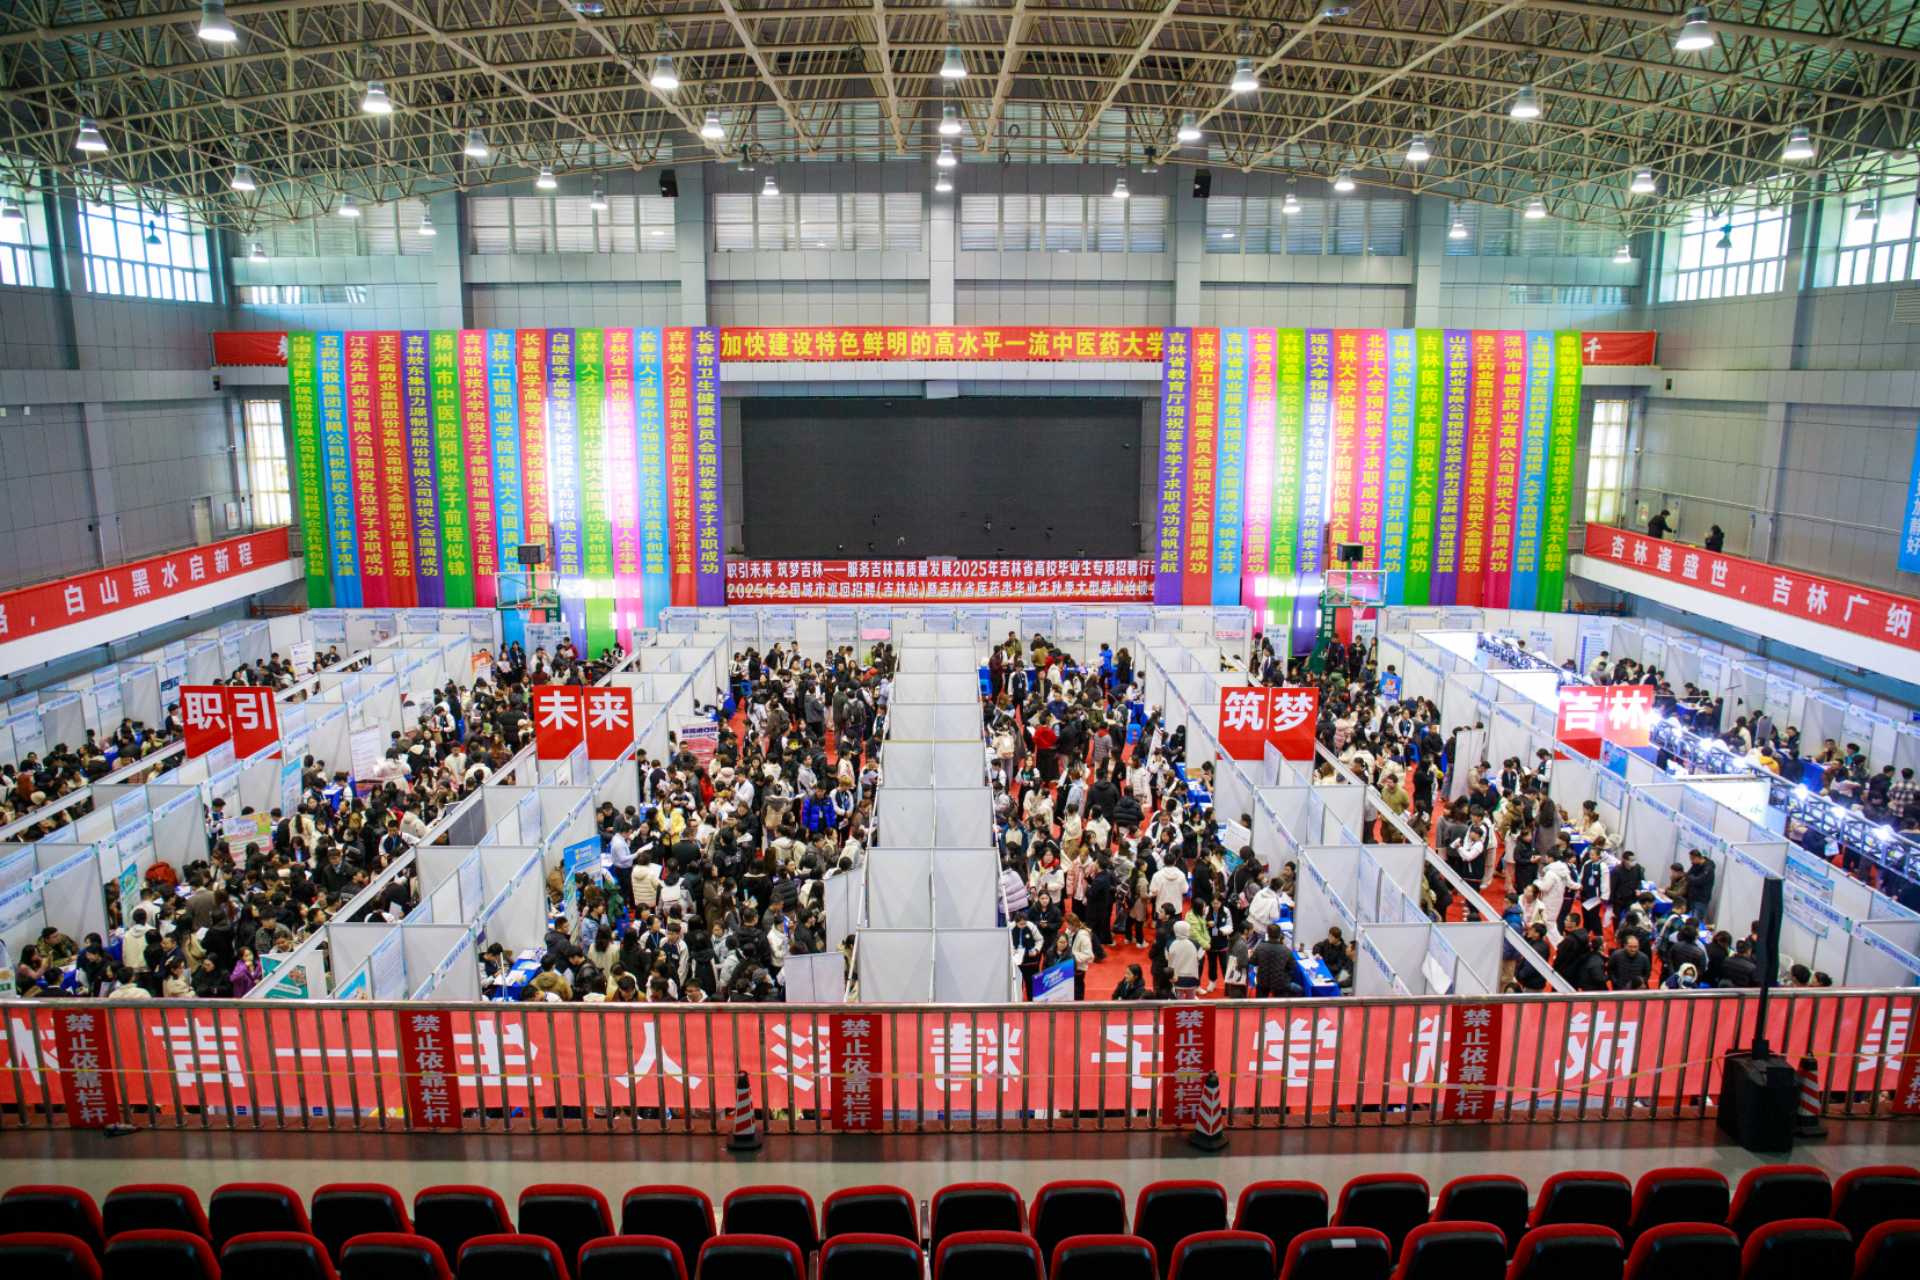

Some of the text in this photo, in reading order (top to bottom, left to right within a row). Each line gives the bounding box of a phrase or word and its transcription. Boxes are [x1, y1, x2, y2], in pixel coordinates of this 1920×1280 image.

[721, 331, 1163, 357] 加快建设特色鲜明的高水平一流中医药大学
[433, 334, 466, 576] 扬州市中医院预祝学子前程似锦
[695, 330, 720, 575] 长春市卫生健康委员会预祝莘莘学子求职成功
[1159, 331, 1187, 574] 吉林省教育厅预祝莘莘学子求职成功扬帆起航
[1189, 332, 1217, 574] 吉林省卫生健康委员会预祝大会圆满成功
[1409, 335, 1440, 573] 吉林医药学院预祝大会圆满成功
[1489, 335, 1523, 573] 深圳市康哲药业有限公司预祝大会圆满成功
[184, 691, 272, 731] 职引
[538, 690, 630, 731] 未来
[1222, 691, 1314, 732] 筑梦
[1562, 690, 1648, 731] 吉林
[64, 1013, 107, 1123] 禁止依靠栏杆
[412, 1014, 452, 1123] 禁止依靠栏杆
[841, 1018, 873, 1127] 禁止依靠栏杆
